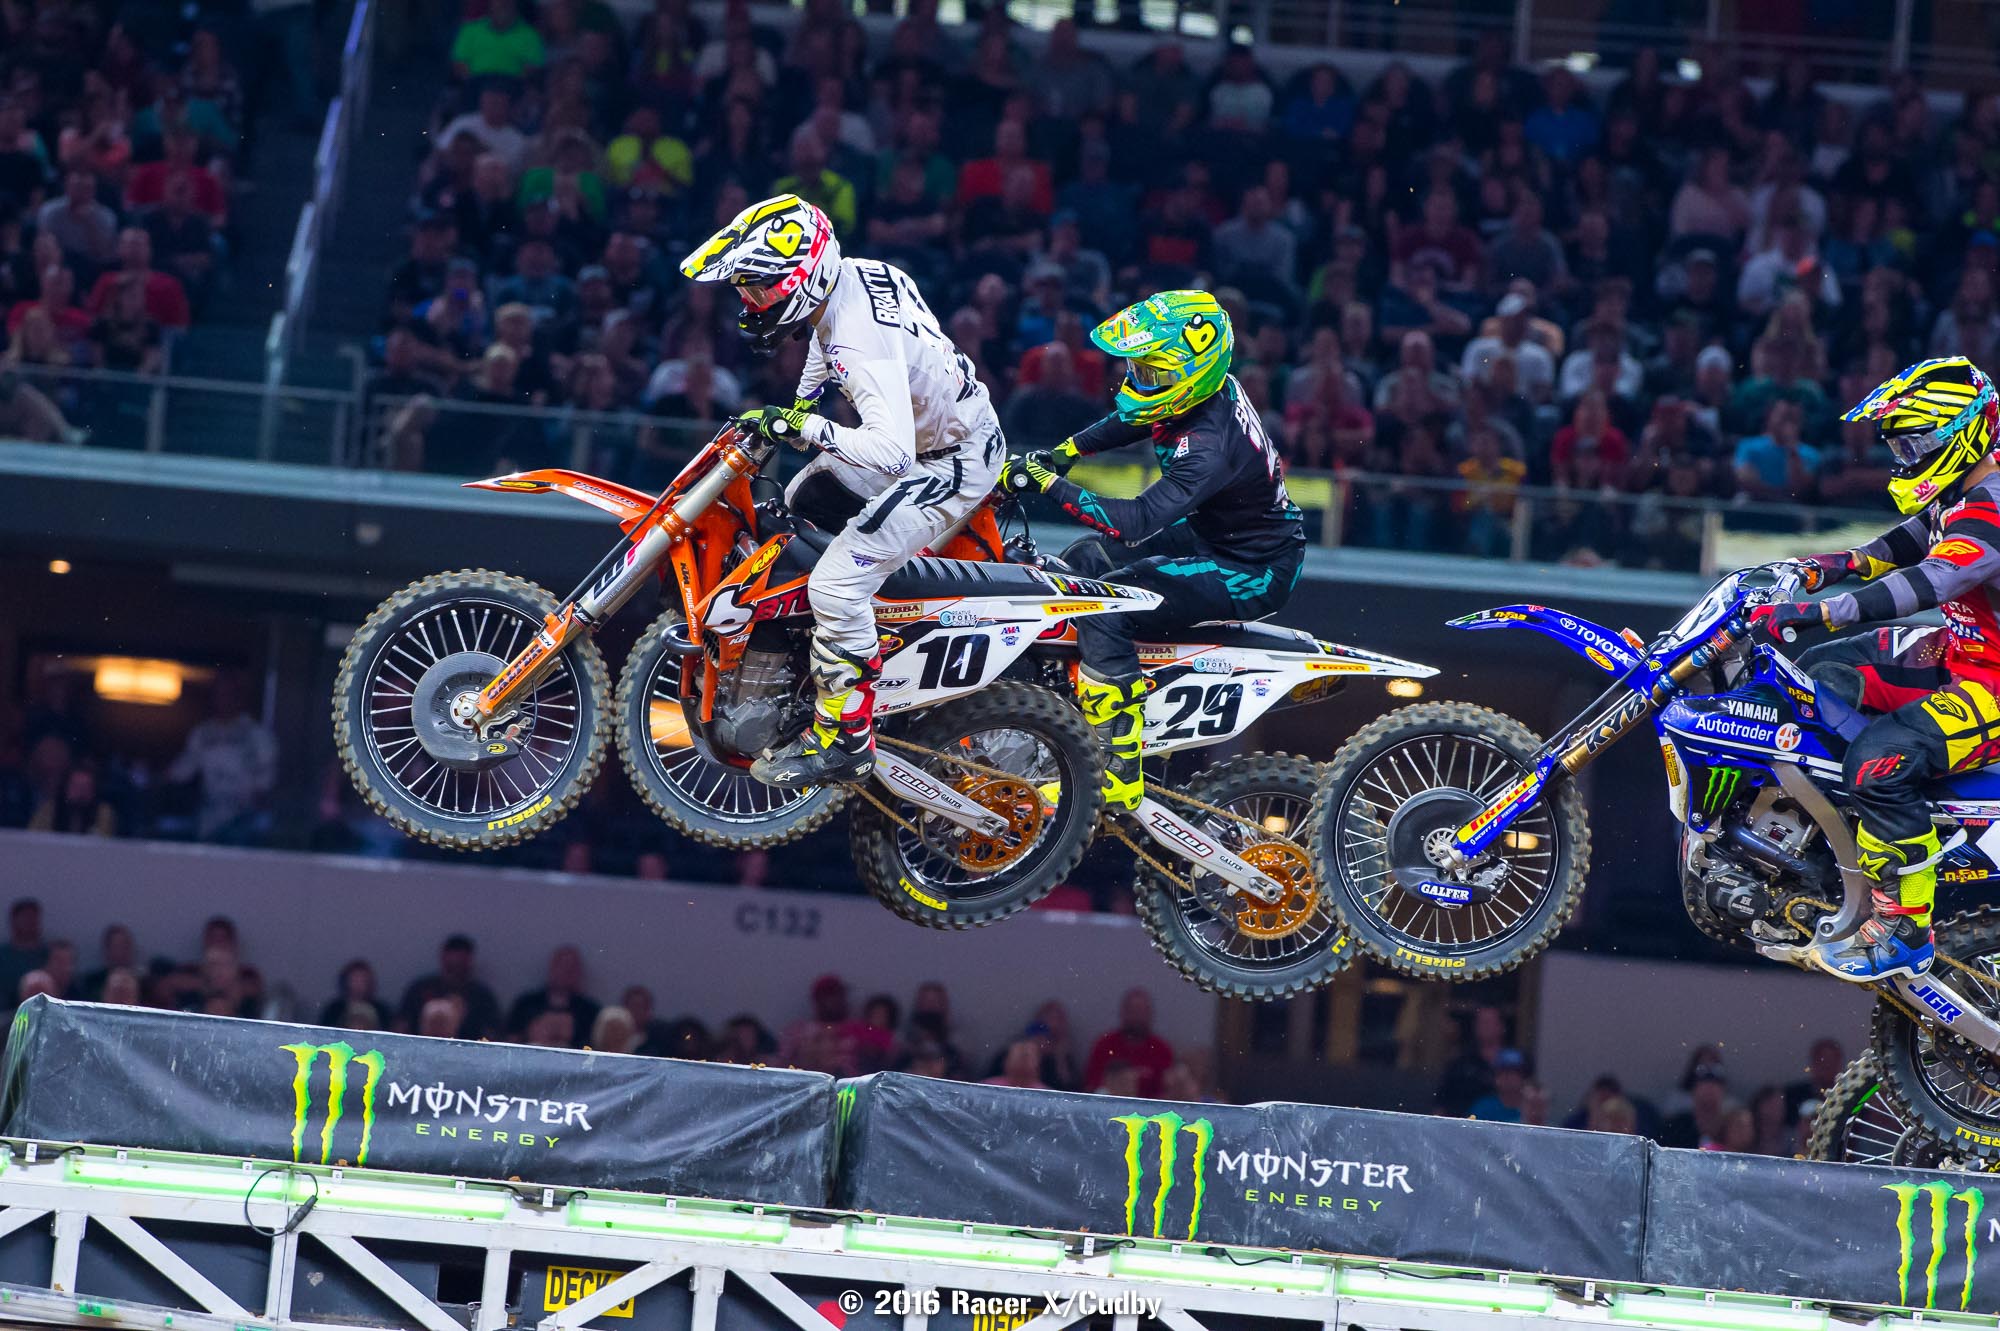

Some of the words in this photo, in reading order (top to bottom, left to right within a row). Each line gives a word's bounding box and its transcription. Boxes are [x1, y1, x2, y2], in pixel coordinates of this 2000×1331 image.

[874, 605, 920, 615] BUBBA
[1050, 603, 1100, 613] PIRELLI
[1137, 646, 1173, 655] UBBA
[1576, 625, 1631, 664] TOYOTA
[916, 634, 990, 689] 10
[1156, 683, 1244, 741] 29
[1586, 693, 1647, 754] KYB
[1728, 699, 1778, 723] YAMAHA
[1696, 714, 1773, 742] Autotrader
[889, 766, 940, 800] Talon
[1856, 754, 1902, 786] FLY
[487, 794, 553, 831] PIRELLI
[1963, 818, 1989, 826] FRAM
[1150, 811, 1214, 858] Talon
[1219, 855, 1244, 872] GALFER
[898, 877, 948, 911] PIRELLI
[1420, 883, 1469, 901] GALFER
[1395, 947, 1466, 969] PIRELLI
[1908, 983, 1963, 1021] JGR
[416, 1123, 560, 1149] ENERGY
[1955, 1126, 2000, 1148] RELLI
[1245, 1189, 1382, 1212] ENERGY
